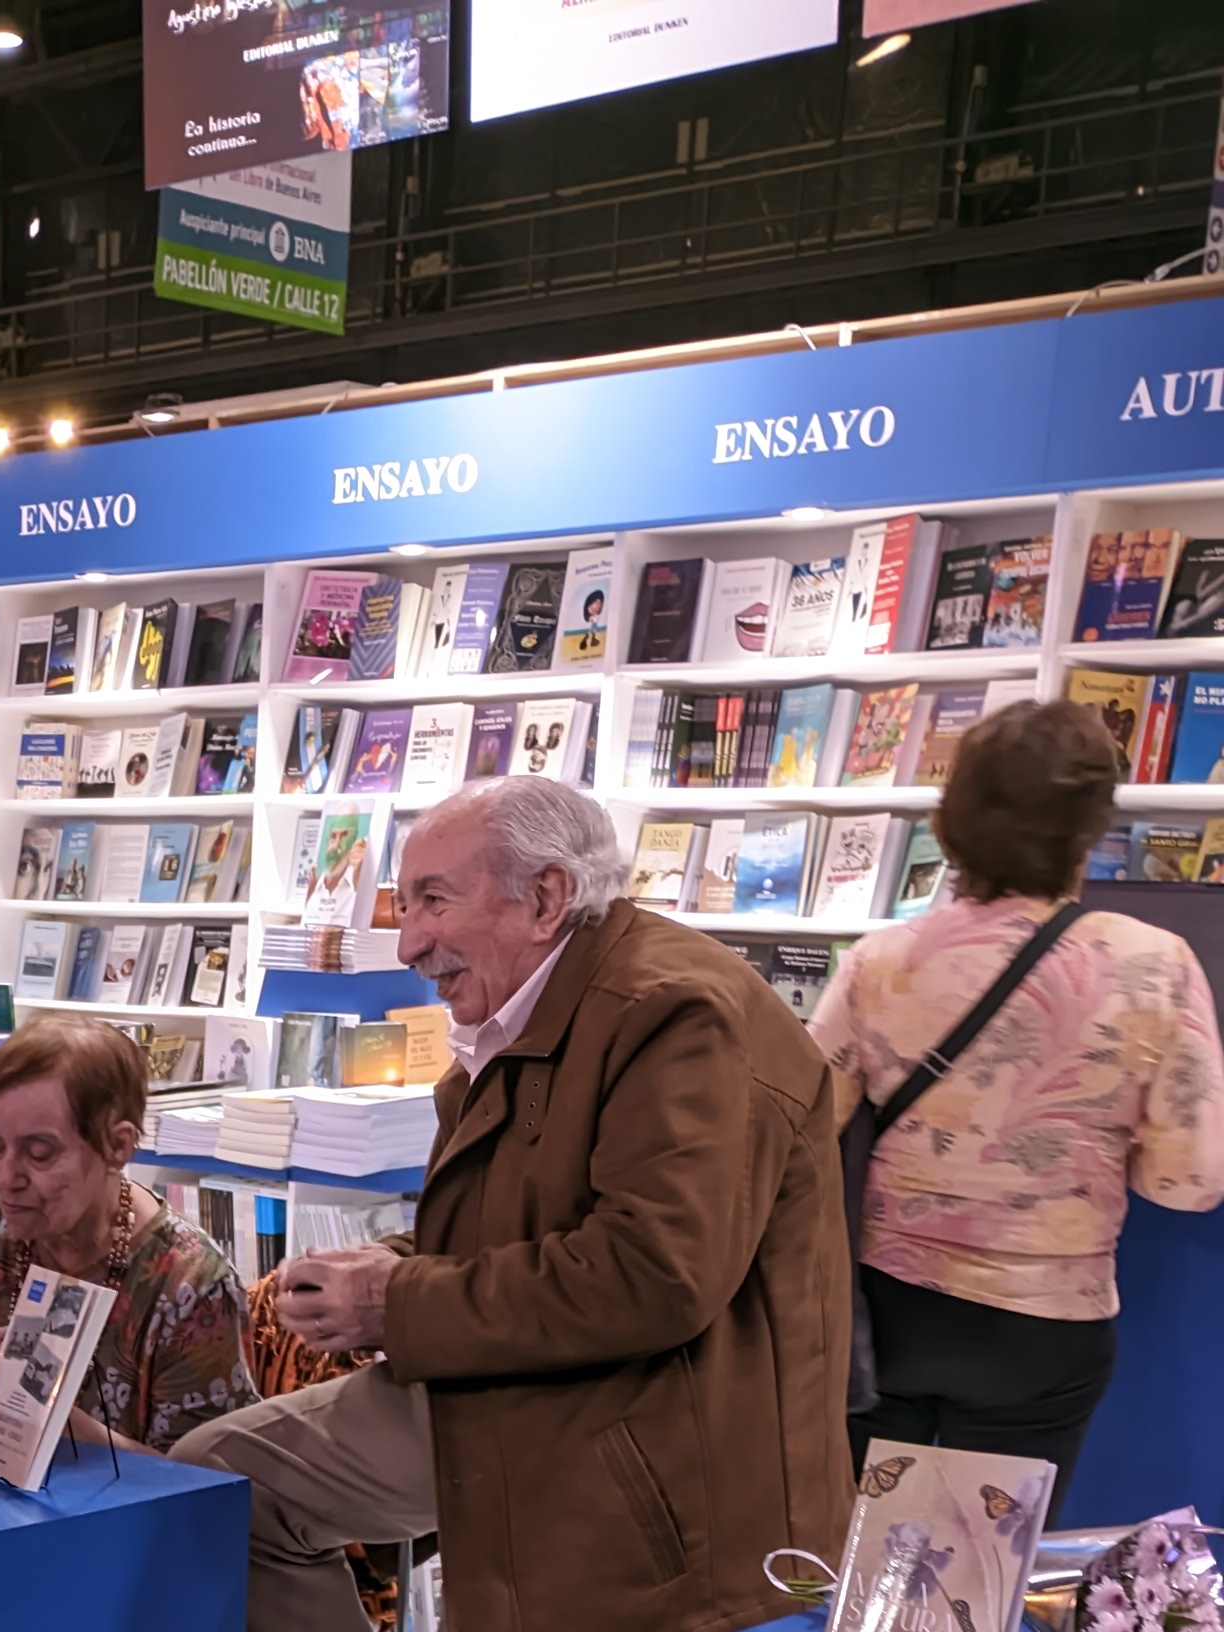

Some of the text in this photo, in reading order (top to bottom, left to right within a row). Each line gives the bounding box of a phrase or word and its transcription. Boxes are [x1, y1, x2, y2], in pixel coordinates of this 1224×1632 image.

[184, 111, 261, 138] La historia
[264, 175, 274, 191] de
[276, 177, 301, 199] Buenos
[302, 186, 322, 205] Aires
[179, 208, 325, 265] Auspiciante principal BNA
[162, 254, 339, 320] PABELLÓN VERDE / CALLE 12
[1119, 368, 1224, 421] AUT
[713, 405, 896, 465] ENSAYO
[332, 453, 478, 505] ENSAYO
[19, 494, 137, 536] ENSAYO
